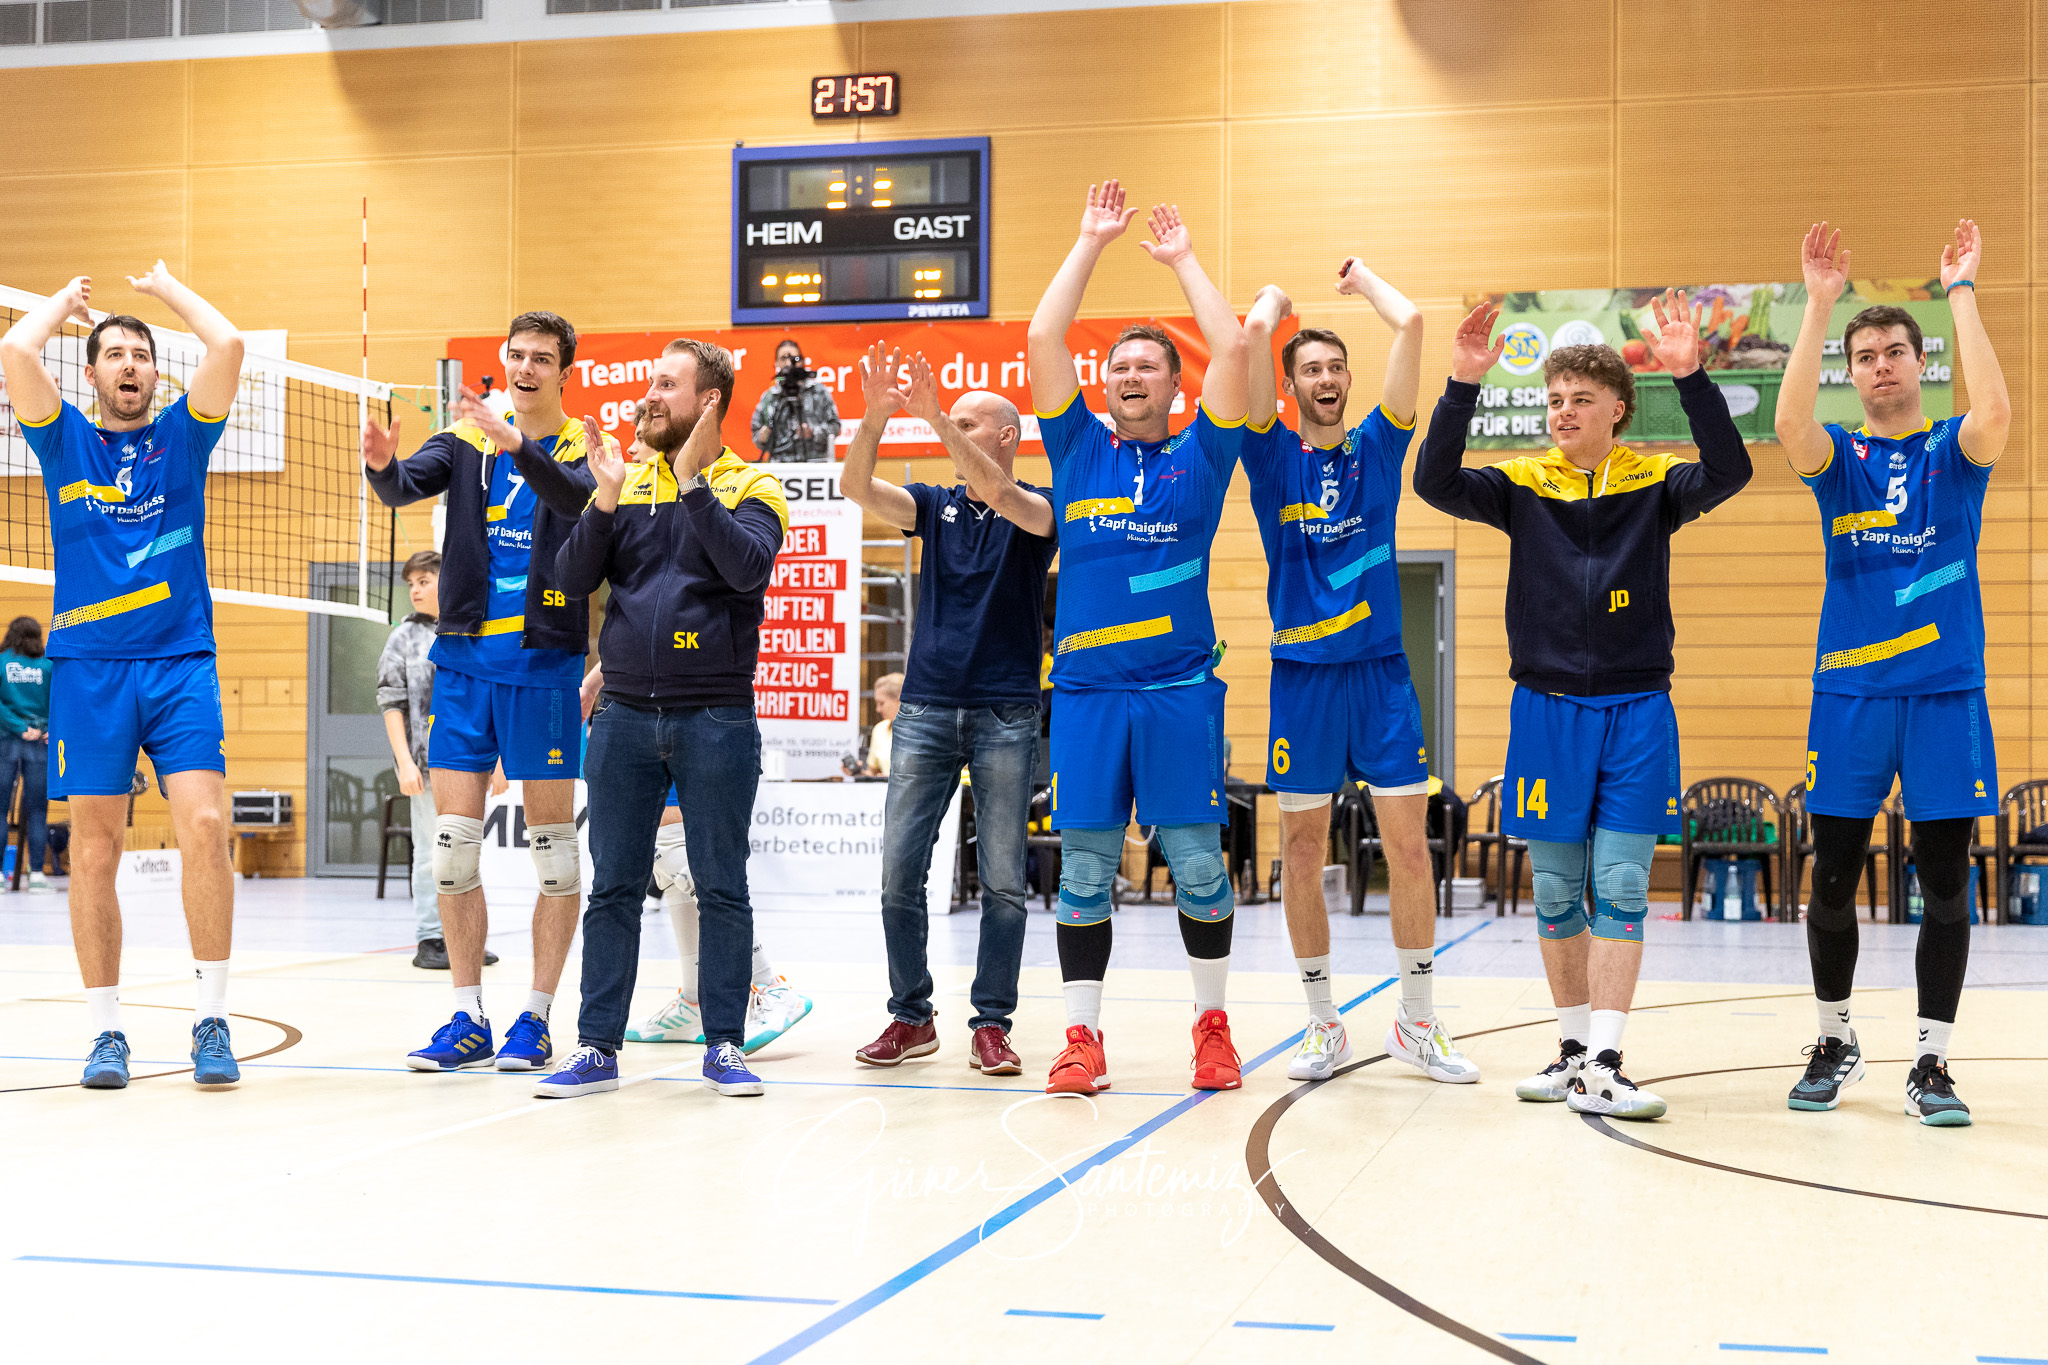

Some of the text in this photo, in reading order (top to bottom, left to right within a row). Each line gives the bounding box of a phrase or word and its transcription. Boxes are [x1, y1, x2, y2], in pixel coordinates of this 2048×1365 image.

[814, 75, 893, 114] 21:57
[746, 214, 971, 246] HEIM GAST
[908, 303, 970, 318] PEWETA
[940, 352, 989, 390] du
[1470, 412, 1543, 437] FÜR DIE
[507, 472, 526, 510] 7
[710, 484, 737, 493] chwaig
[1319, 479, 1340, 512] 6
[1884, 472, 1909, 515] 5
[1098, 515, 1178, 536] Zapf Daigfuss
[1861, 530, 1891, 545] Zapf
[543, 589, 566, 607] SB
[1608, 589, 1630, 613] JD
[673, 631, 700, 649] SK
[1272, 737, 1291, 775] 6
[1805, 750, 1819, 792] 5
[1516, 776, 1549, 820] 14
